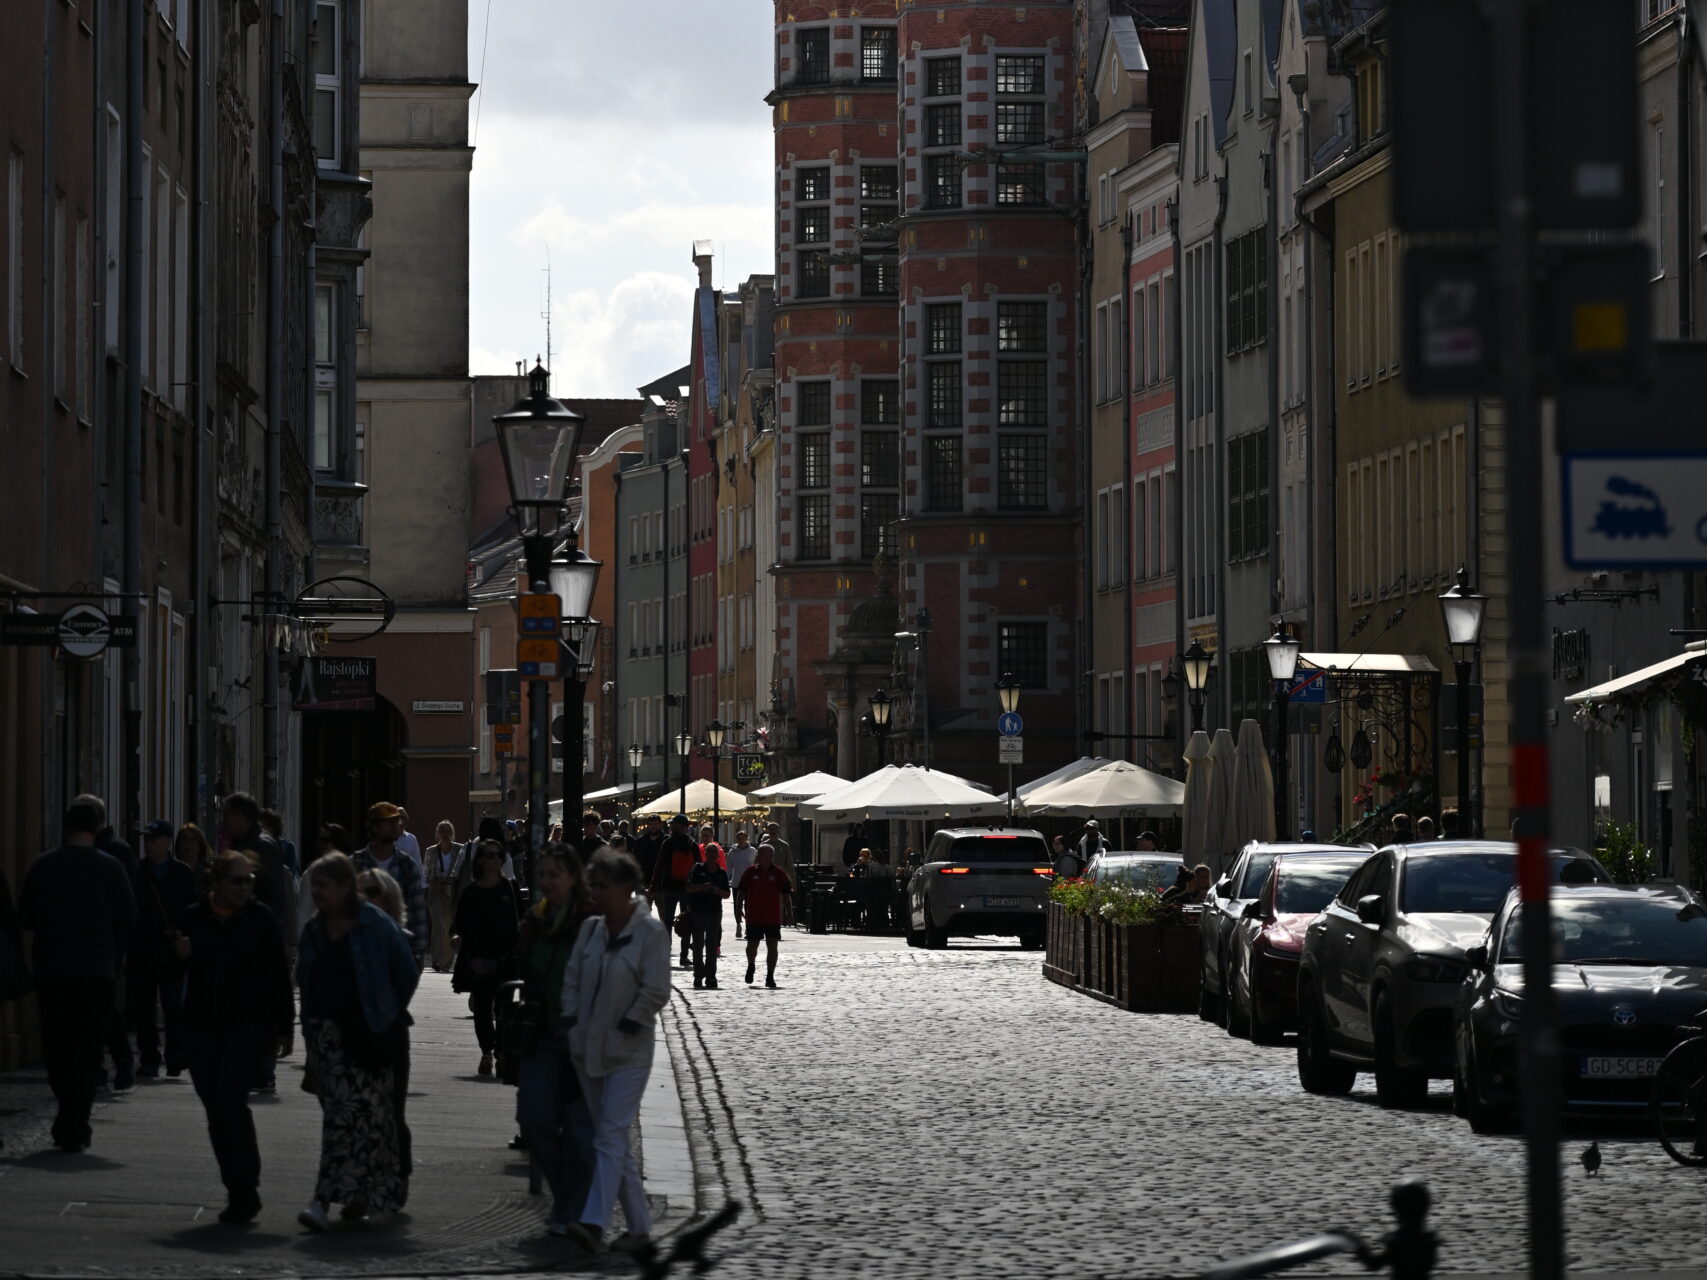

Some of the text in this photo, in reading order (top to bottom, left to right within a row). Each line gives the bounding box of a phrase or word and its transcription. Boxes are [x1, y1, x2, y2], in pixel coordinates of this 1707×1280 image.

[113, 626, 133, 637] ATM
[320, 659, 369, 679] Rajstopki
[1591, 1058, 1611, 1074] GD
